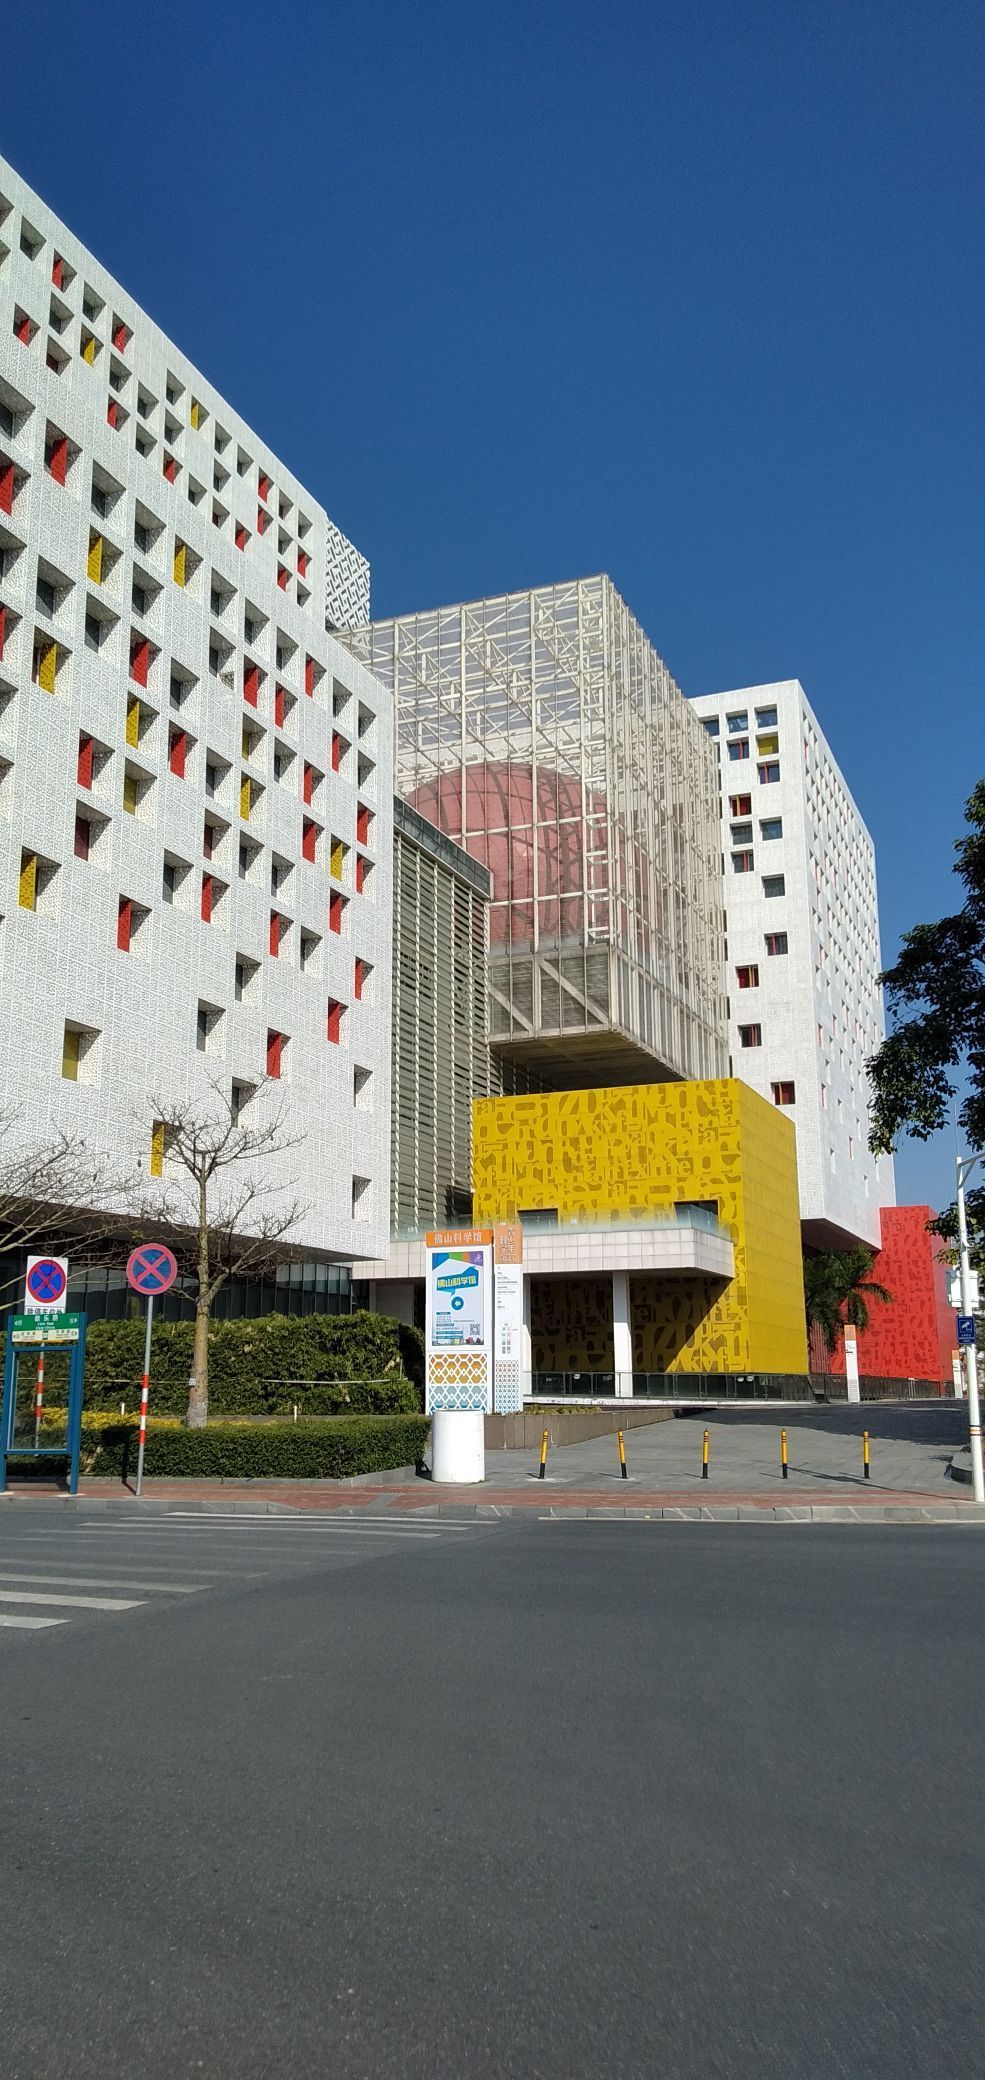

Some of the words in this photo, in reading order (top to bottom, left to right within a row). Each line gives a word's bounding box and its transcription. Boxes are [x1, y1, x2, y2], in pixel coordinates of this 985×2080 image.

[434, 1231, 483, 1244] 佛山科学馆
